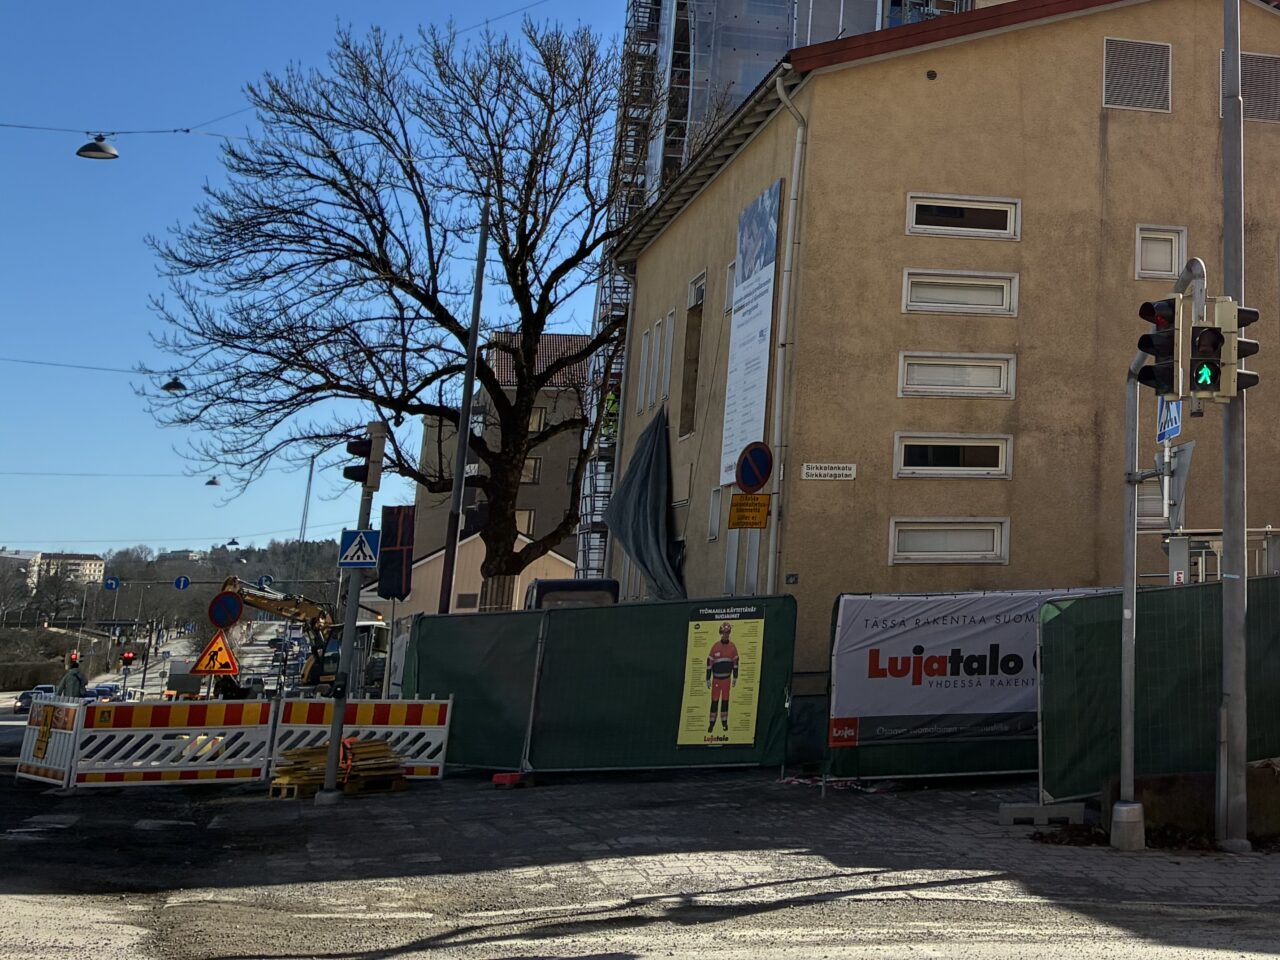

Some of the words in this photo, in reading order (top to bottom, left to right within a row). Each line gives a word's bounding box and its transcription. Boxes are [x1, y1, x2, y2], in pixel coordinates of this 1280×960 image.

[805, 472, 853, 480] Sirkkalagatan
[863, 616, 907, 629] TÄSSÄ
[914, 614, 987, 628] RAKENTAA
[868, 644, 1024, 686] Lujatalo
[928, 677, 982, 689] YHDESSÄ
[703, 734, 729, 743] Lujatalo
[832, 727, 855, 739] Luja
